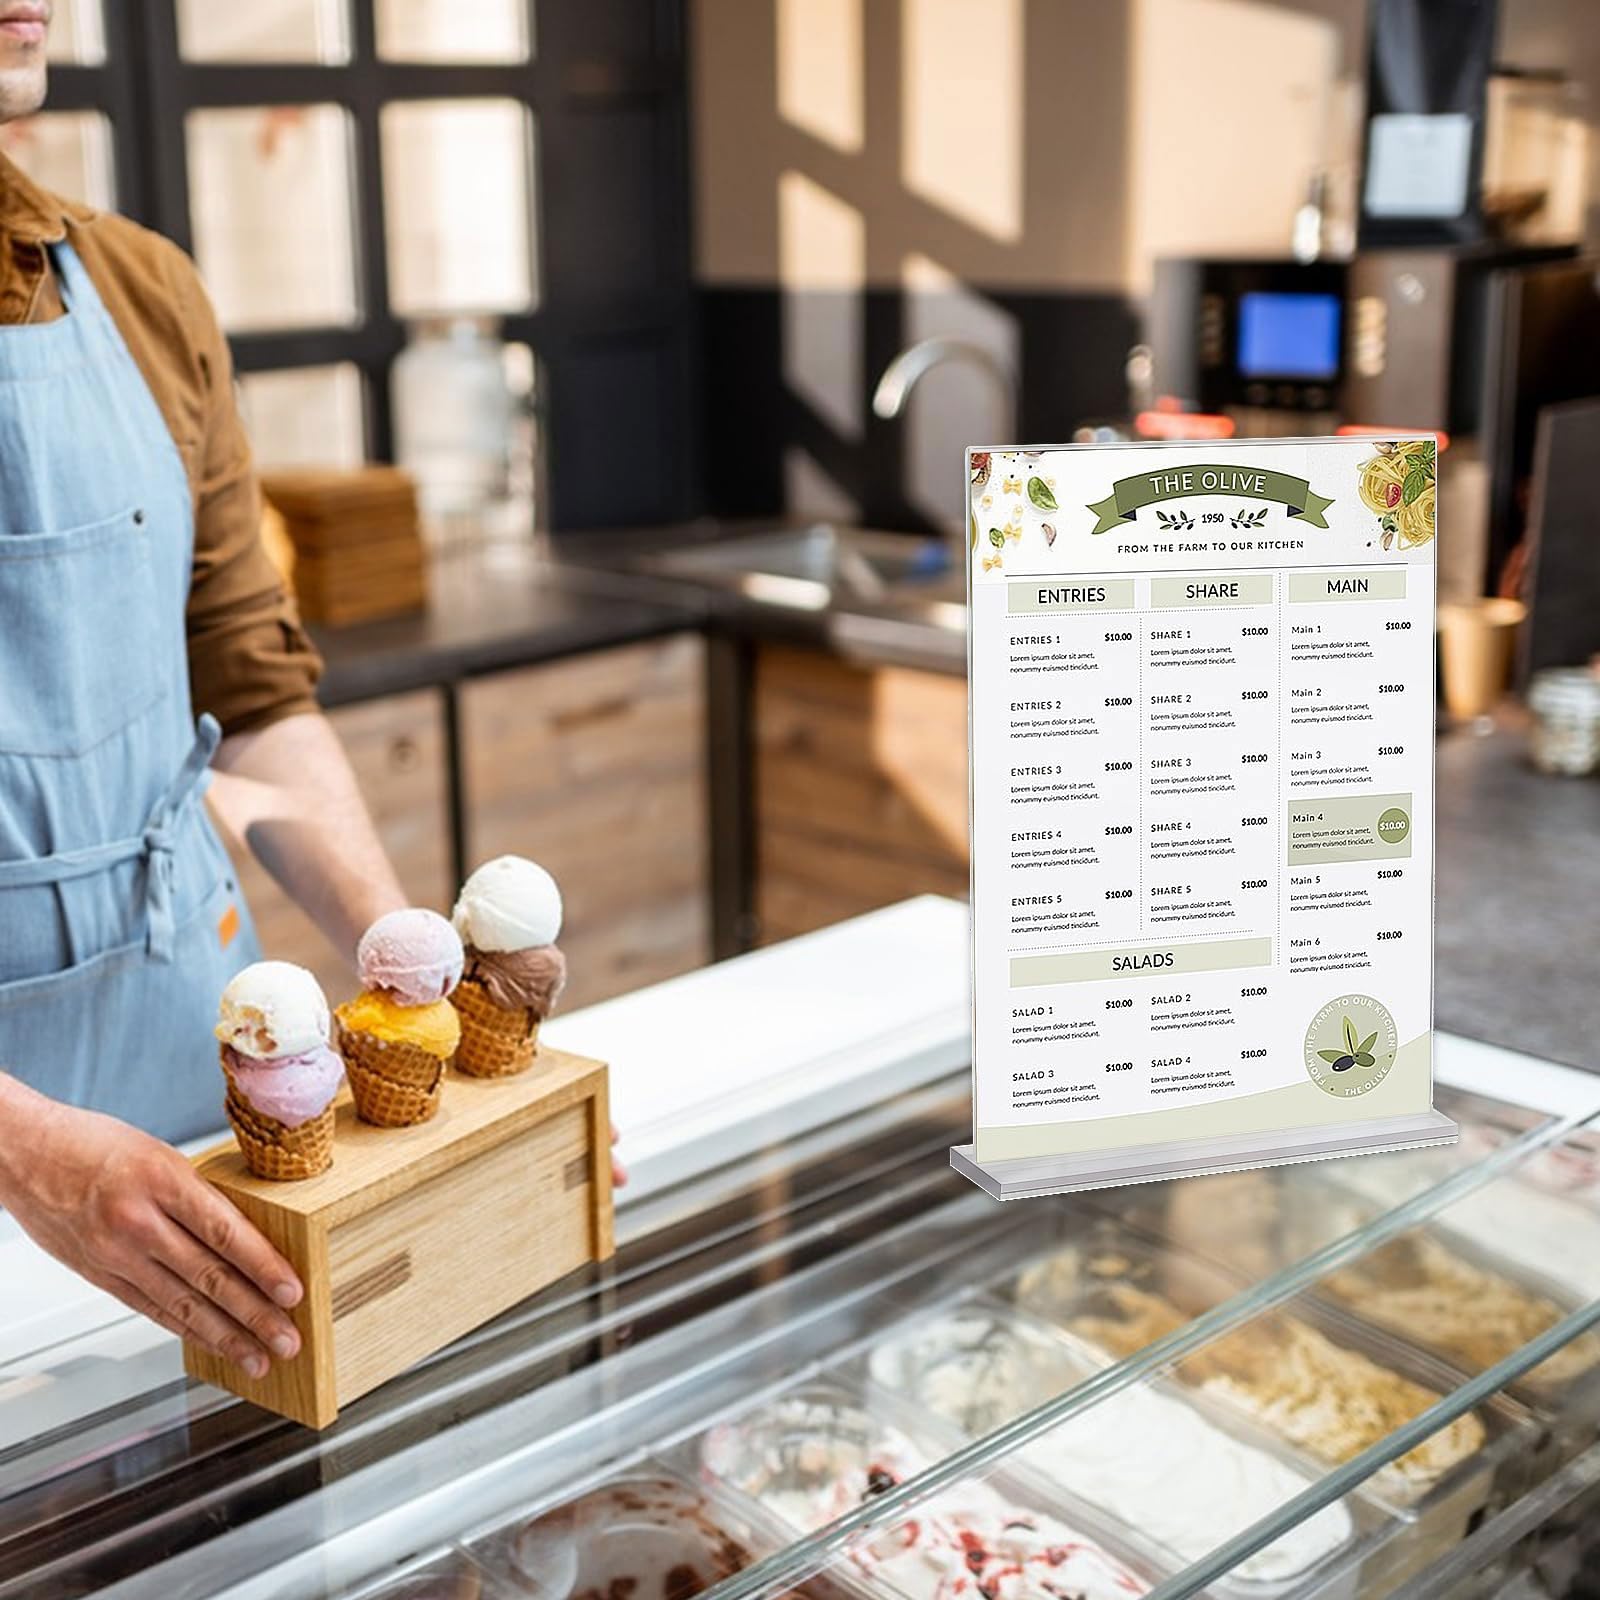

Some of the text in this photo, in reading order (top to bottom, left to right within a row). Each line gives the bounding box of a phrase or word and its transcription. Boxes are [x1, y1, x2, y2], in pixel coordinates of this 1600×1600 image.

[1149, 471, 1267, 494] THE OLIVE
[1201, 513, 1224, 524] 1950
[1118, 540, 1304, 554] FROM THE FARM TO OUR KITCHEN
[1185, 583, 1239, 599] SHARE
[1326, 578, 1369, 594] MAIN
[1037, 587, 1106, 604] ENTRIES
[1150, 627, 1269, 640] SHARE 1 $10.00
[1291, 621, 1412, 634] Main 1 $10.00
[1010, 632, 1133, 646] ENTRIES 1 $10.00
[1150, 690, 1268, 705] SHARE 2 $10.00
[1291, 684, 1405, 698] Main 2 $10.00
[1010, 697, 1133, 712] ENTRIES 2 $10.00
[1150, 753, 1268, 769] SHARE 3 $10.00
[1291, 746, 1404, 760] Main 3 $10.00
[1010, 761, 1133, 777] ENTRIES 3 $10.00
[1150, 816, 1268, 833] SHARE 4 $10.00
[1292, 812, 1324, 823] Main 4
[1011, 825, 1133, 842] ENTRIES 4 $10.00
[1380, 822, 1406, 831] $10.00
[1290, 869, 1403, 885] Main 5 $10.00
[1150, 879, 1268, 897] SHARE 5 $10.00
[1011, 889, 1133, 907] ENTRIES 5 $10.00
[1290, 930, 1403, 948] Main 6 $10.00
[1111, 952, 1174, 972] SALADS
[1151, 987, 1267, 1006] SALAD 2 $10.00
[1012, 998, 1133, 1018] SALAD 1 $10.00
[1306, 996, 1396, 1087] FROM THE FARM TO OUR KITCHEN
[1151, 1048, 1267, 1068] SALAD 4 $10.00
[1012, 1062, 1133, 1082] SALAD 3 $10.00
[1344, 1066, 1388, 1096] THE OLIVE
